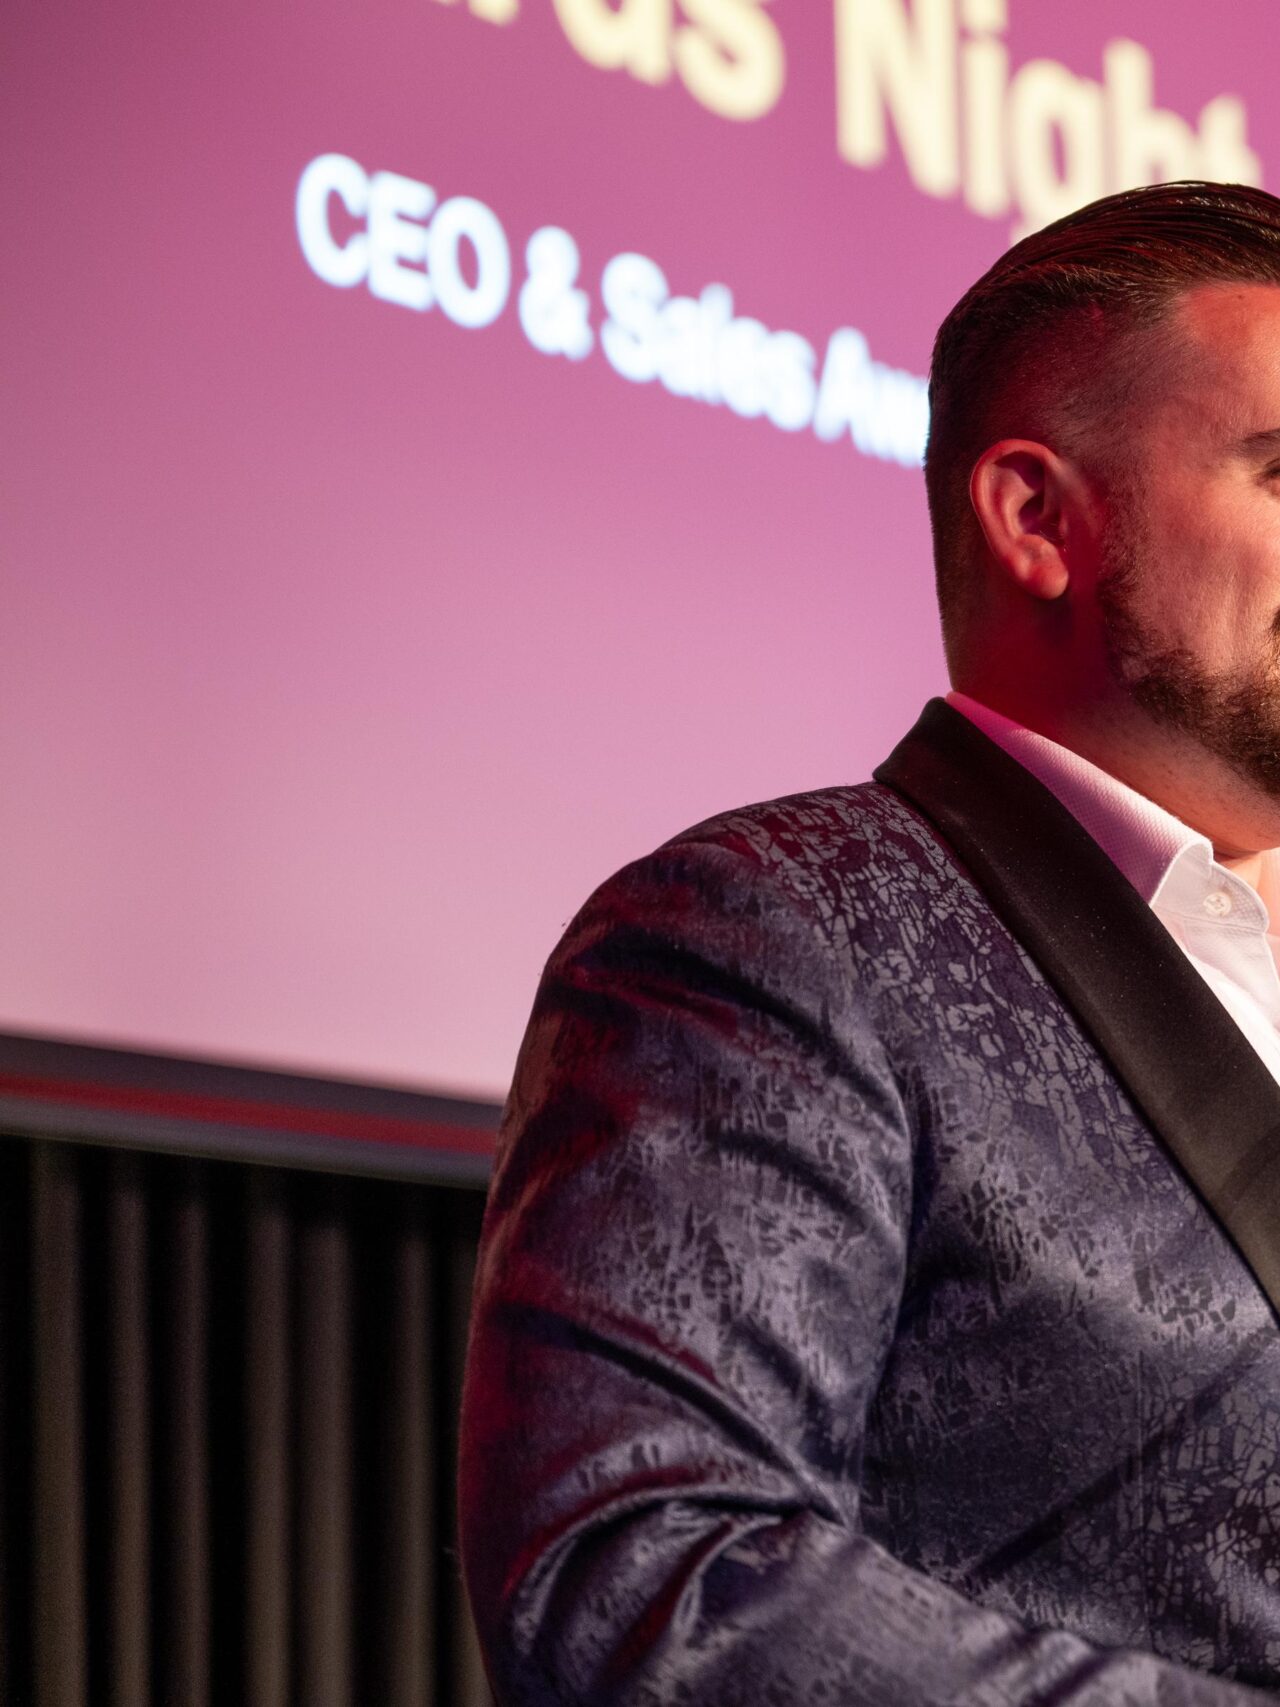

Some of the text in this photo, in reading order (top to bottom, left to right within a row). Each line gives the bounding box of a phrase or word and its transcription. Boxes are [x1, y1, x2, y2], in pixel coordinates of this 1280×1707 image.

[297, 153, 509, 328] CEO
[519, 227, 593, 360] &
[600, 253, 817, 431] Sales
